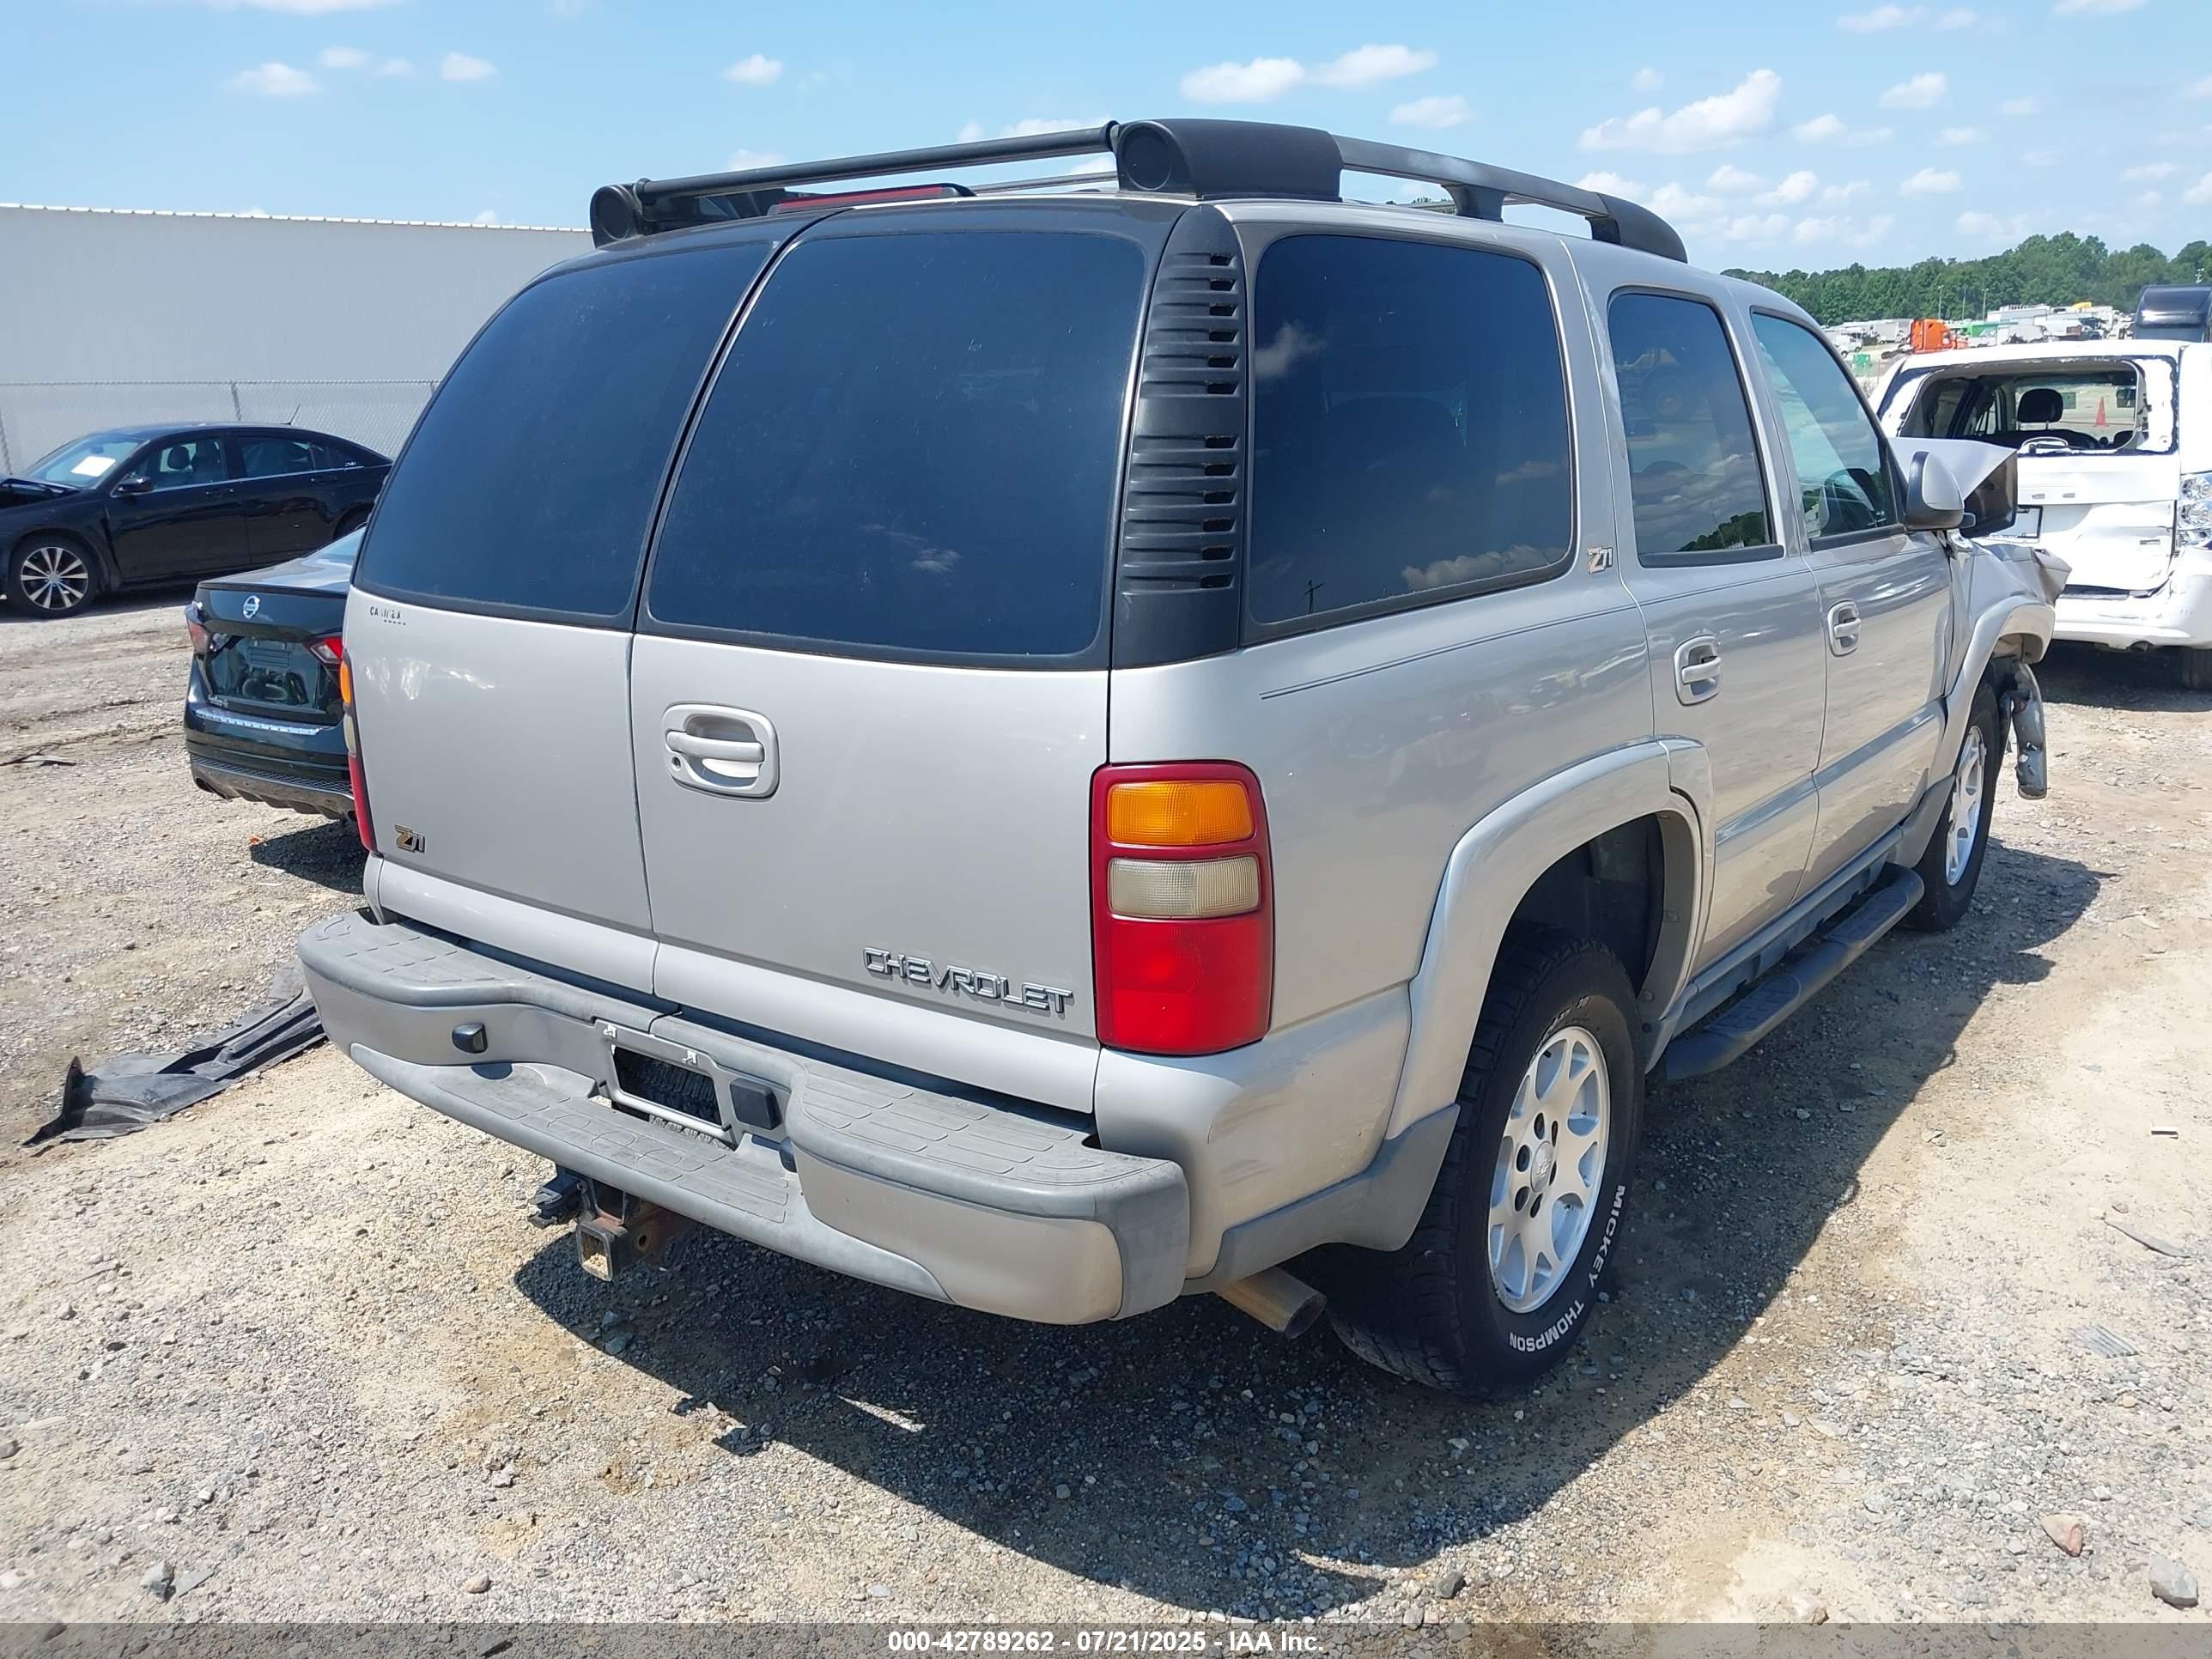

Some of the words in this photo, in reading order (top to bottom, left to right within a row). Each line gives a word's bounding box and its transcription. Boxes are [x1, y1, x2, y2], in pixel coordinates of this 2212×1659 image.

[862, 945, 1073, 1014] CHEVROLET
[1588, 1184, 1626, 1288] MICKEY
[1509, 1298, 1585, 1352] THOMPSON
